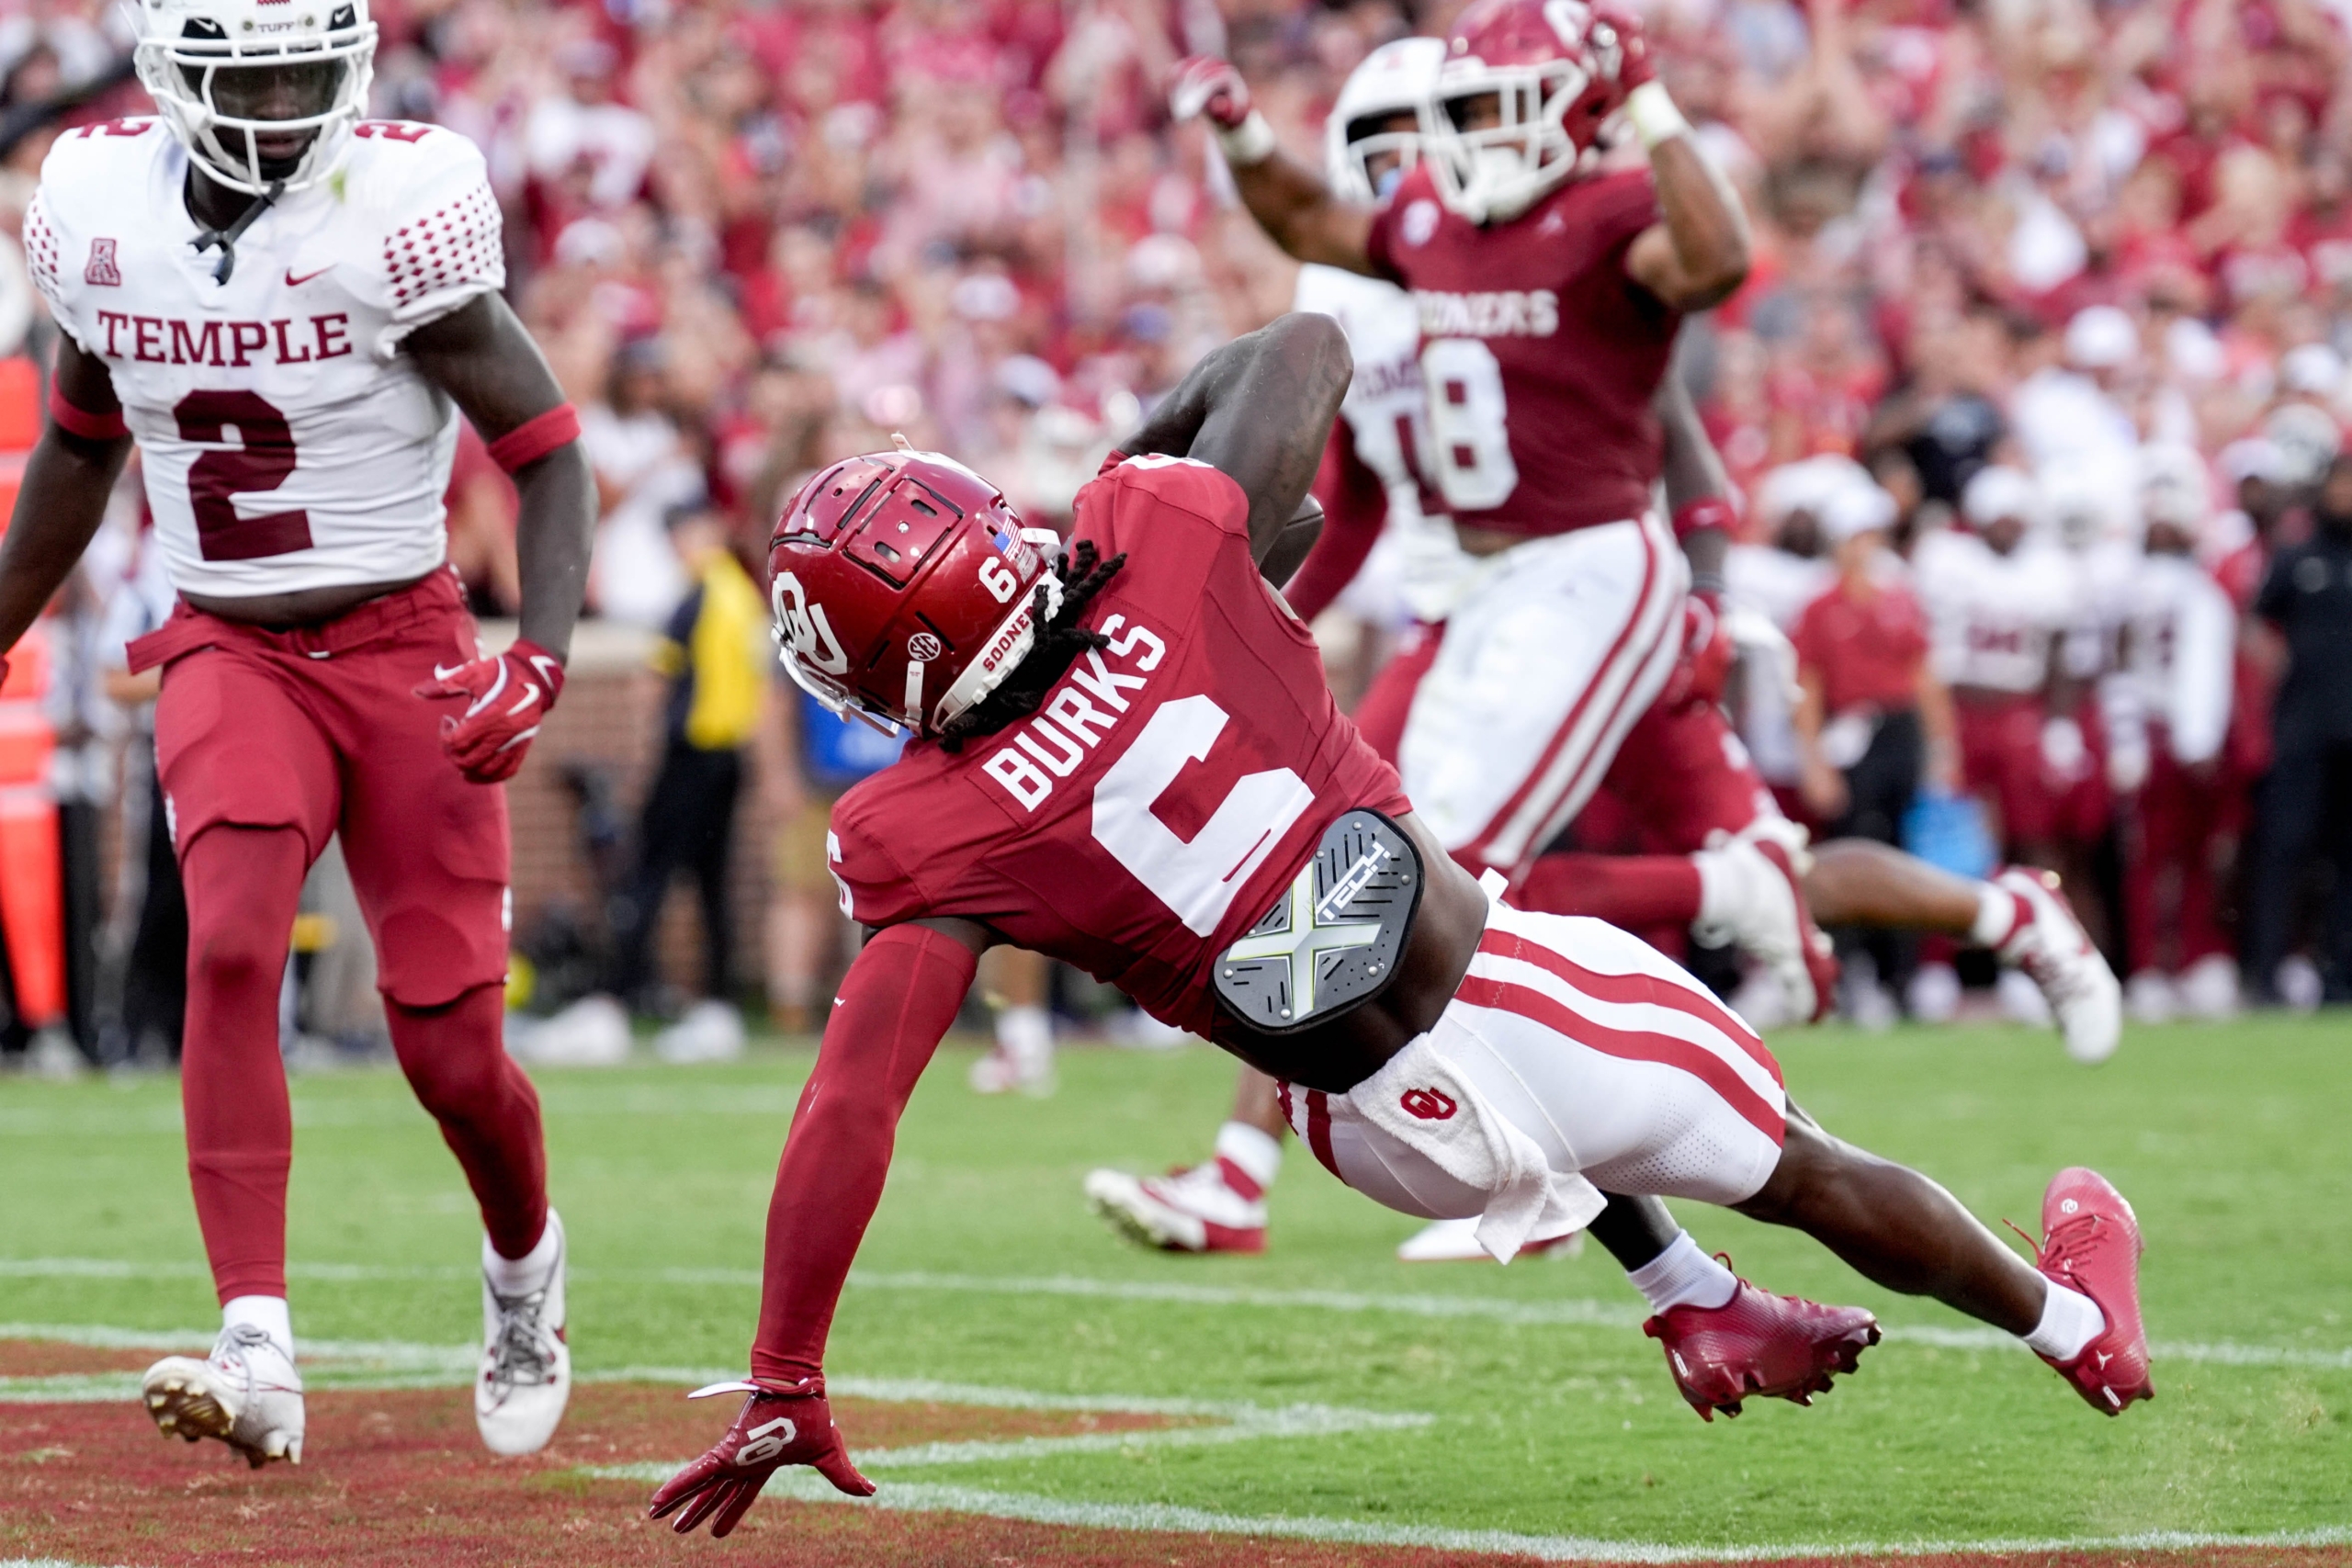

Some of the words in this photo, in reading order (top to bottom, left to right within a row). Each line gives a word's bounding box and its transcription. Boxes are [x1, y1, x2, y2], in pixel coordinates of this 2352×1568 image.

[258, 21, 294, 32] TUFF
[97, 310, 352, 367] TEMPLE
[1422, 337, 1520, 511] 8
[173, 389, 315, 562] 2
[978, 556, 1017, 604] 6
[909, 633, 940, 661] SEC
[982, 604, 1036, 672] SOONER
[981, 614, 1166, 812] BURKS
[1091, 694, 1316, 938] 6
[1400, 1087, 1458, 1120] OU
